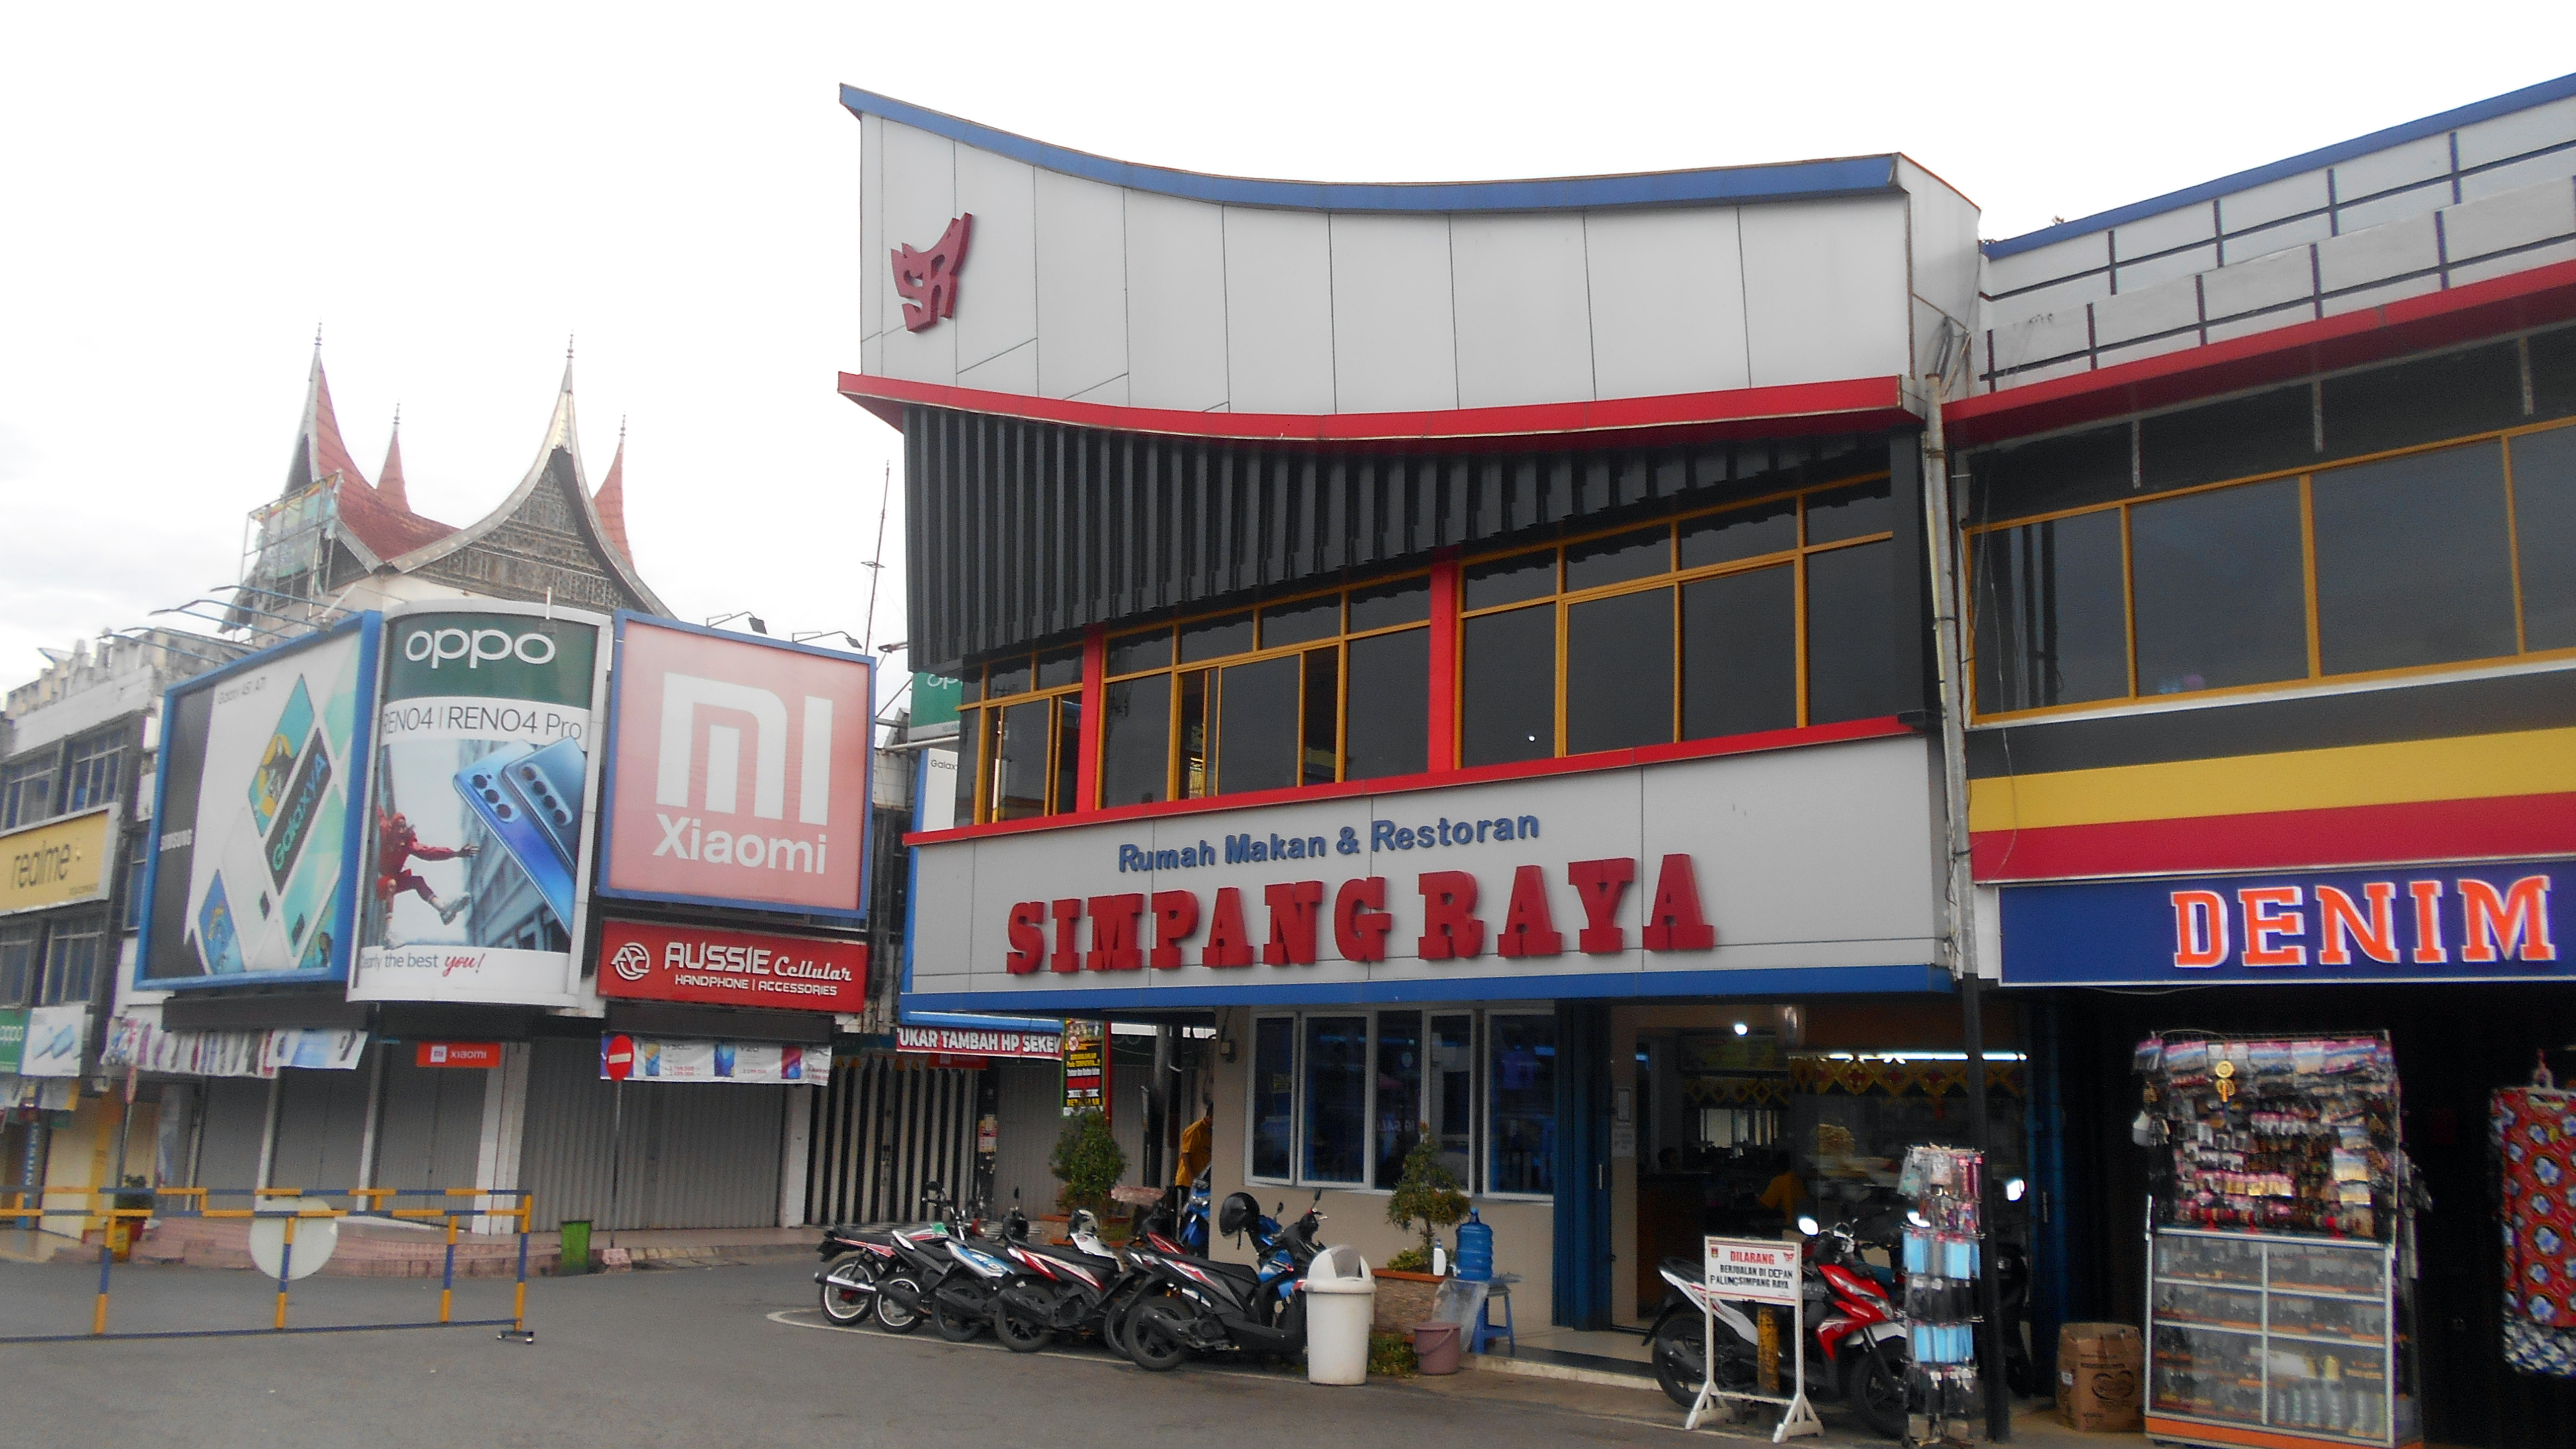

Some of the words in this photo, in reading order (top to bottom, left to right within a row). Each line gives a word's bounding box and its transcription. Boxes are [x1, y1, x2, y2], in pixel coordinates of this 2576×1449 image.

[448, 706, 538, 734] RENO4
[545, 712, 583, 740] Pro
[653, 813, 828, 874] Xiaomi
[1118, 843, 1216, 872] Rumah
[1224, 833, 1326, 865] Makan
[1336, 825, 1360, 855] &
[1371, 814, 1540, 852] Restoran
[1005, 875, 1392, 975] SIMPANG
[1417, 852, 1715, 961] RAYA
[2169, 874, 2557, 969] DENIM
[385, 952, 404, 968] the
[407, 952, 439, 968] best
[664, 941, 772, 975] AUSSIE
[773, 955, 852, 982] Cellular
[675, 974, 749, 990] HANDPHONE
[758, 981, 838, 996] ACCESSORIES
[940, 1030, 999, 1051] TAMBAH
[1001, 1034, 1020, 1052] HP
[1730, 1250, 1775, 1265] DILARANG
[1720, 1264, 1757, 1276] BERJUALAN
[1758, 1267, 1766, 1277] DI
[1768, 1268, 1793, 1280] DEPAN
[1739, 1276, 1770, 1288] SIMPANG
[1772, 1279, 1789, 1290] RAYA
